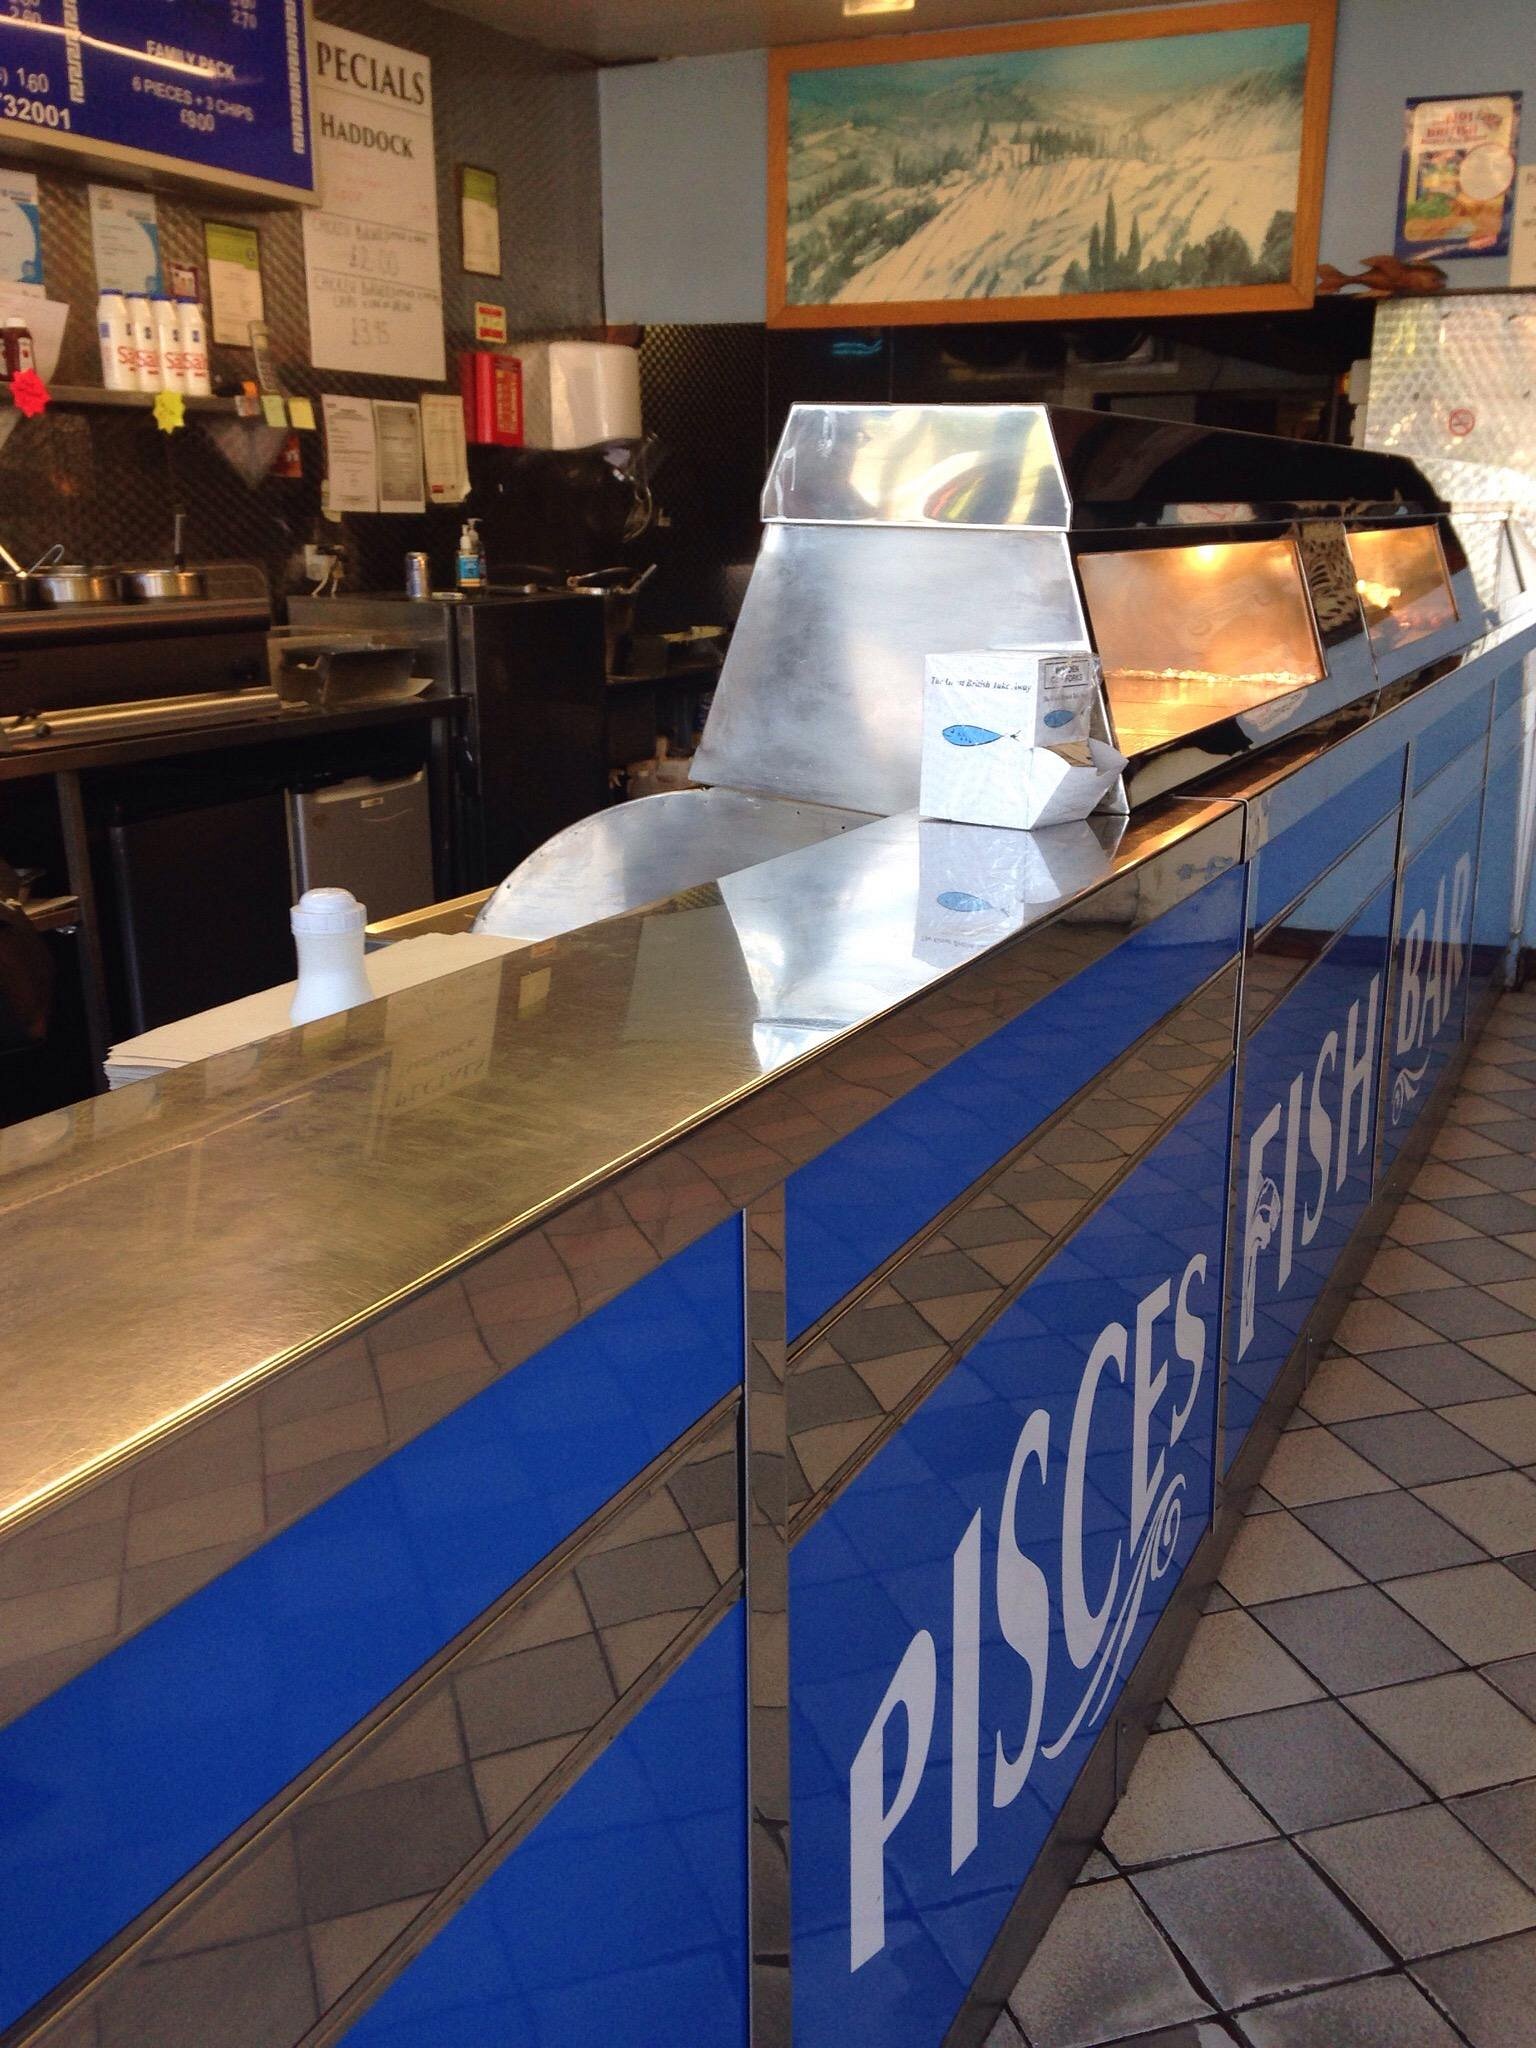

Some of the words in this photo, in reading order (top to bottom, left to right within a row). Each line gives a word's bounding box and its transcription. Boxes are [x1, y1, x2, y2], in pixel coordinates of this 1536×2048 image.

[316, 39, 425, 106] PECIALS
[0, 92, 71, 130] 32001
[143, 78, 193, 106] PIECES
[215, 99, 255, 122] CHIPS
[320, 112, 415, 159] HADDOCK
[965, 678, 990, 689] British
[850, 1253, 1207, 1974] PISCES
[1237, 972, 1381, 1364] FISH
[1397, 852, 1470, 1057] BAR
